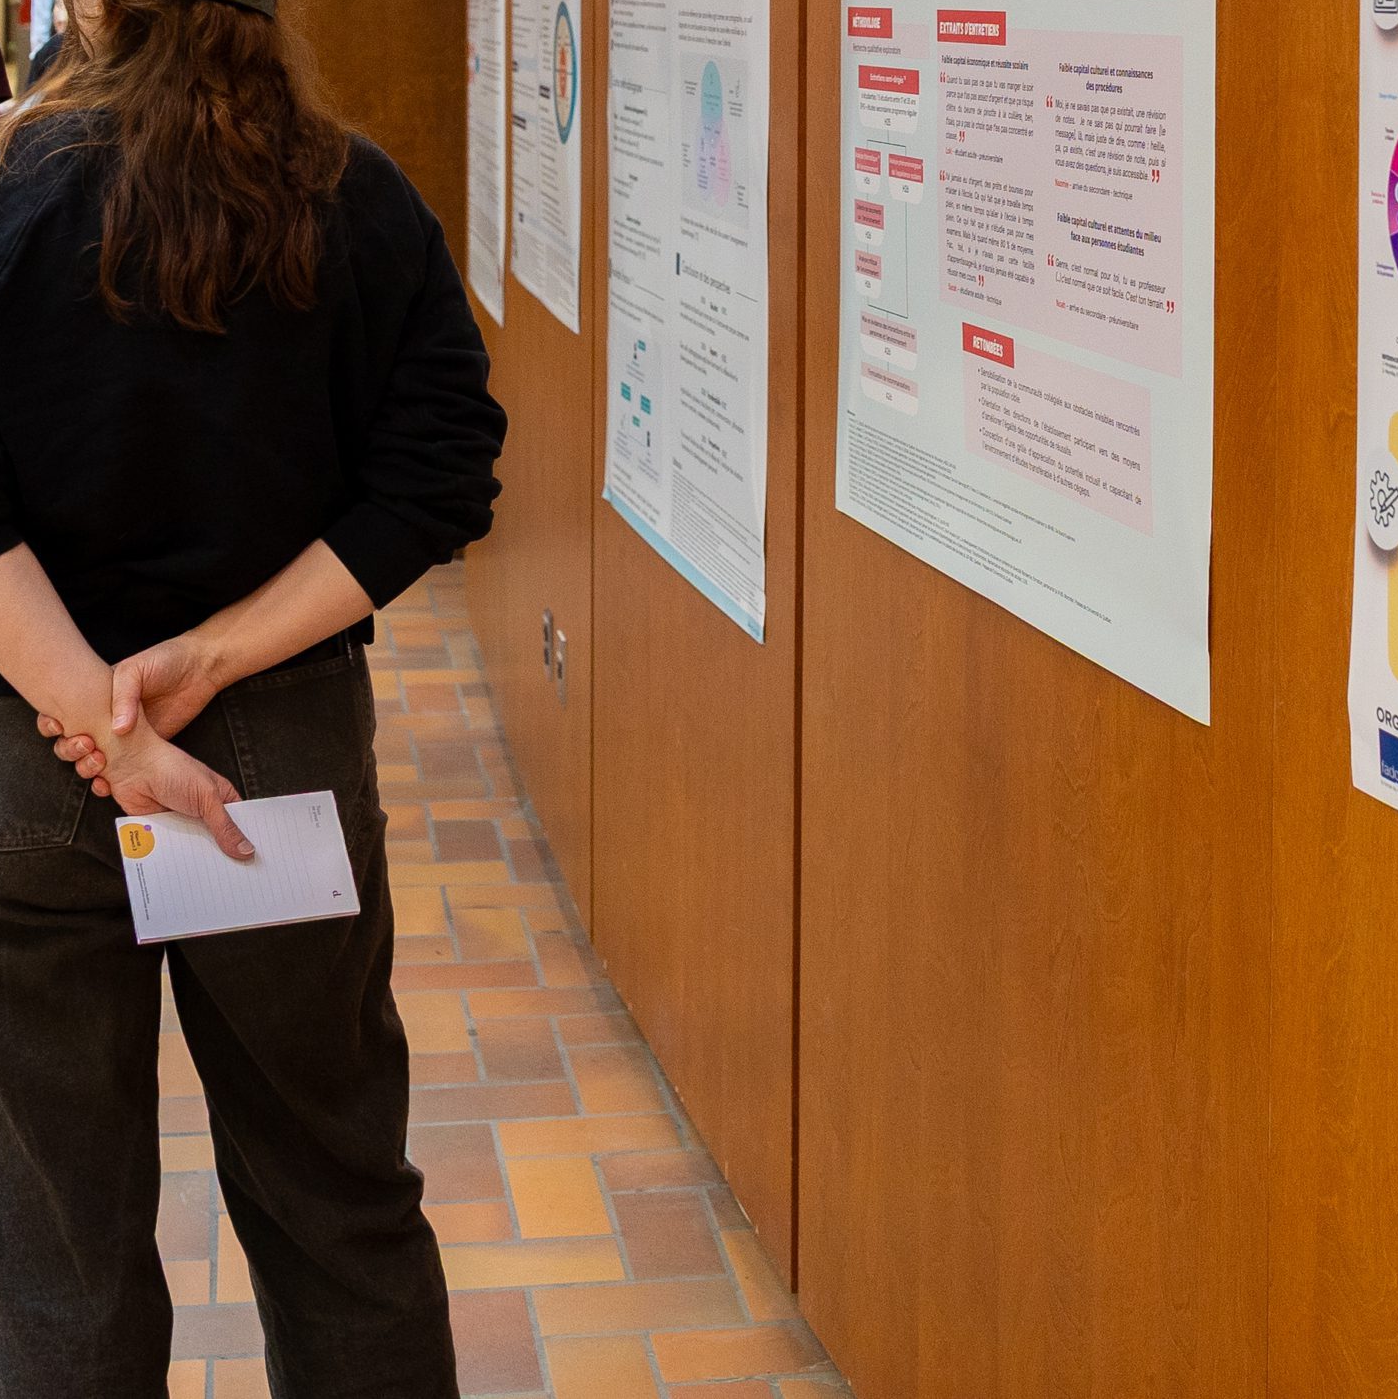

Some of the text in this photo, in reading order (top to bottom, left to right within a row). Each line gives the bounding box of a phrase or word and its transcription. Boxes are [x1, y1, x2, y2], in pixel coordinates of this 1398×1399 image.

[940, 22, 998, 35] EXTRAITS D'ENTRETIENS
[1059, 63, 1152, 79] Faible capital culturel et connaissances
[1086, 81, 1122, 93] des procédures
[1057, 213, 1070, 223] Faible
[1071, 218, 1087, 227] capital
[1088, 220, 1106, 231] culturel
[1114, 227, 1134, 237] attentes
[1136, 229, 1142, 239] du
[1144, 232, 1160, 242] milieu
[1071, 231, 1080, 241] face
[1091, 238, 1115, 249] personnes
[1117, 242, 1143, 256] étudiantes
[973, 336, 1002, 356] RETOMBÉES
